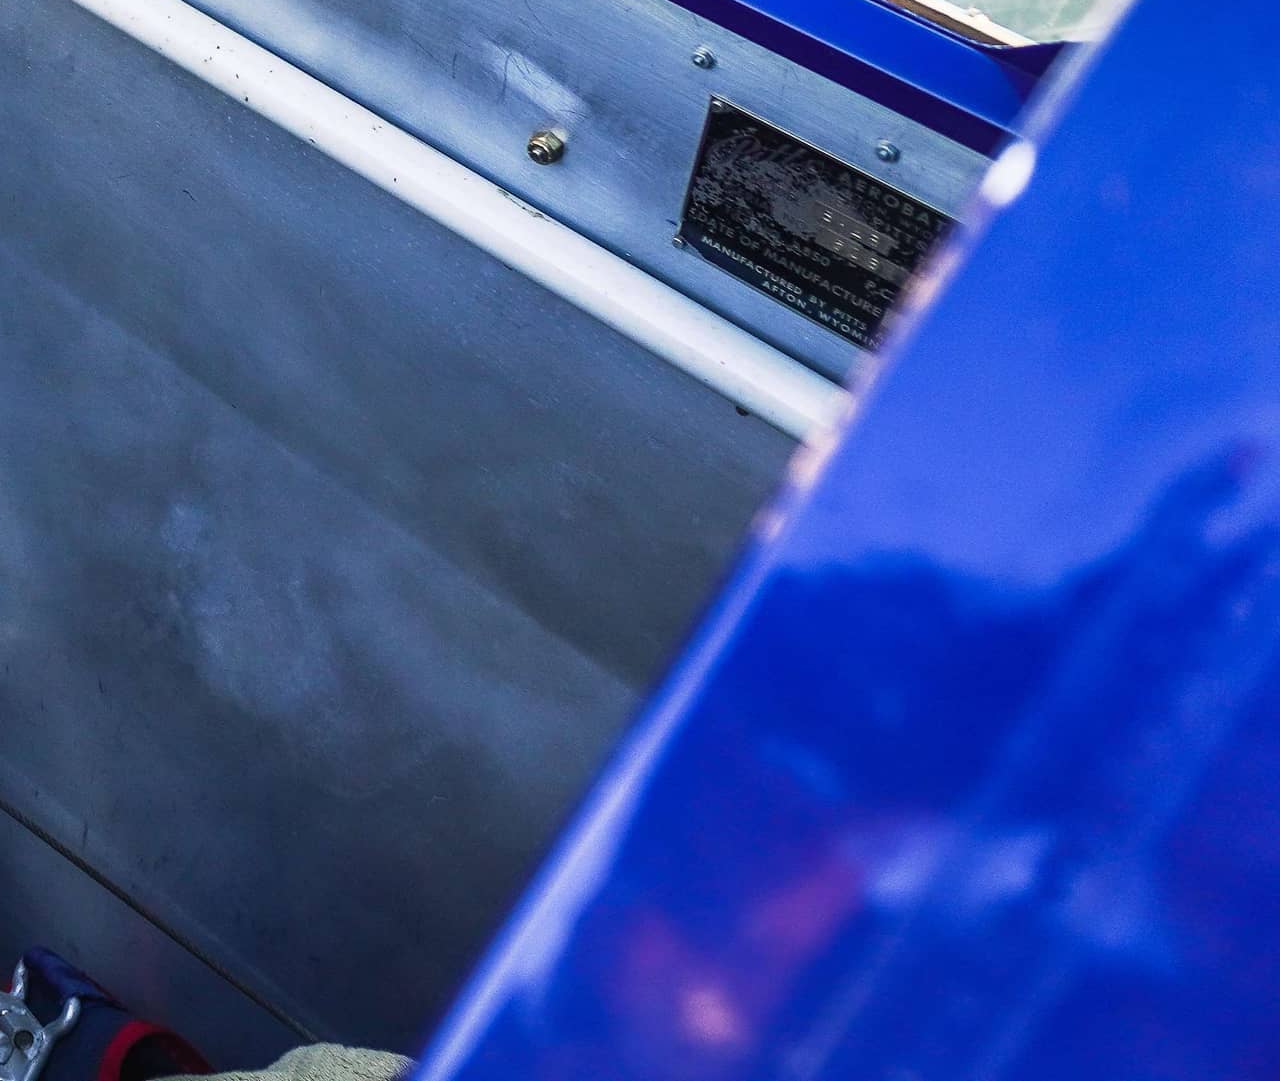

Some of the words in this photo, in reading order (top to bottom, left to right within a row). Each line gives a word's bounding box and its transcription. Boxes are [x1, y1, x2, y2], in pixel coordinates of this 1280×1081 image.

[701, 235, 803, 295] MANUFACTURED
[808, 295, 827, 308] BY
[832, 308, 867, 331] PITTS
[762, 280, 807, 309] AFTON
[818, 311, 881, 349] WYOMIN
